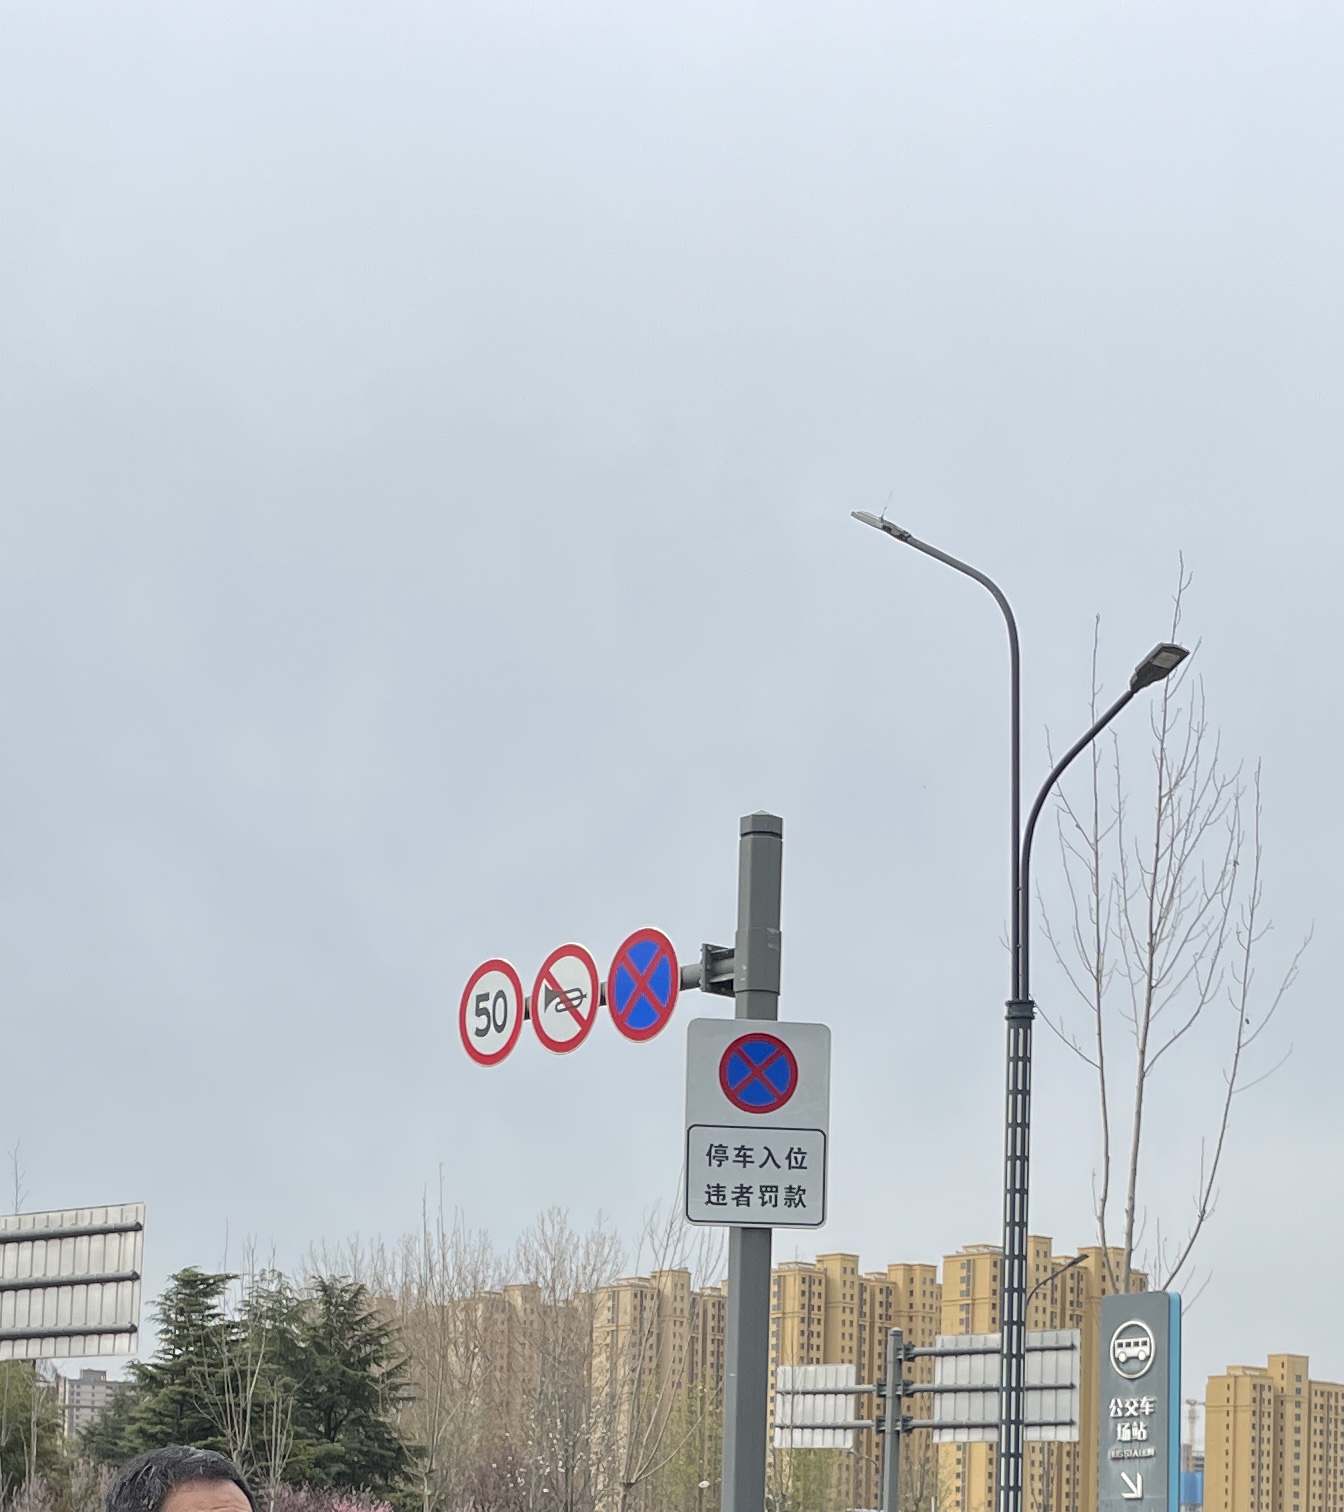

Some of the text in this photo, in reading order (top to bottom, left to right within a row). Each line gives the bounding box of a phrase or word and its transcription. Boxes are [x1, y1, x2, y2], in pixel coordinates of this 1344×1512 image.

[474, 989, 508, 1038] 50
[705, 1143, 809, 1171] 停车入位
[704, 1184, 808, 1210] 违者罚款
[1109, 1396, 1156, 1417] 公交车
[1117, 1421, 1148, 1441] 场站
